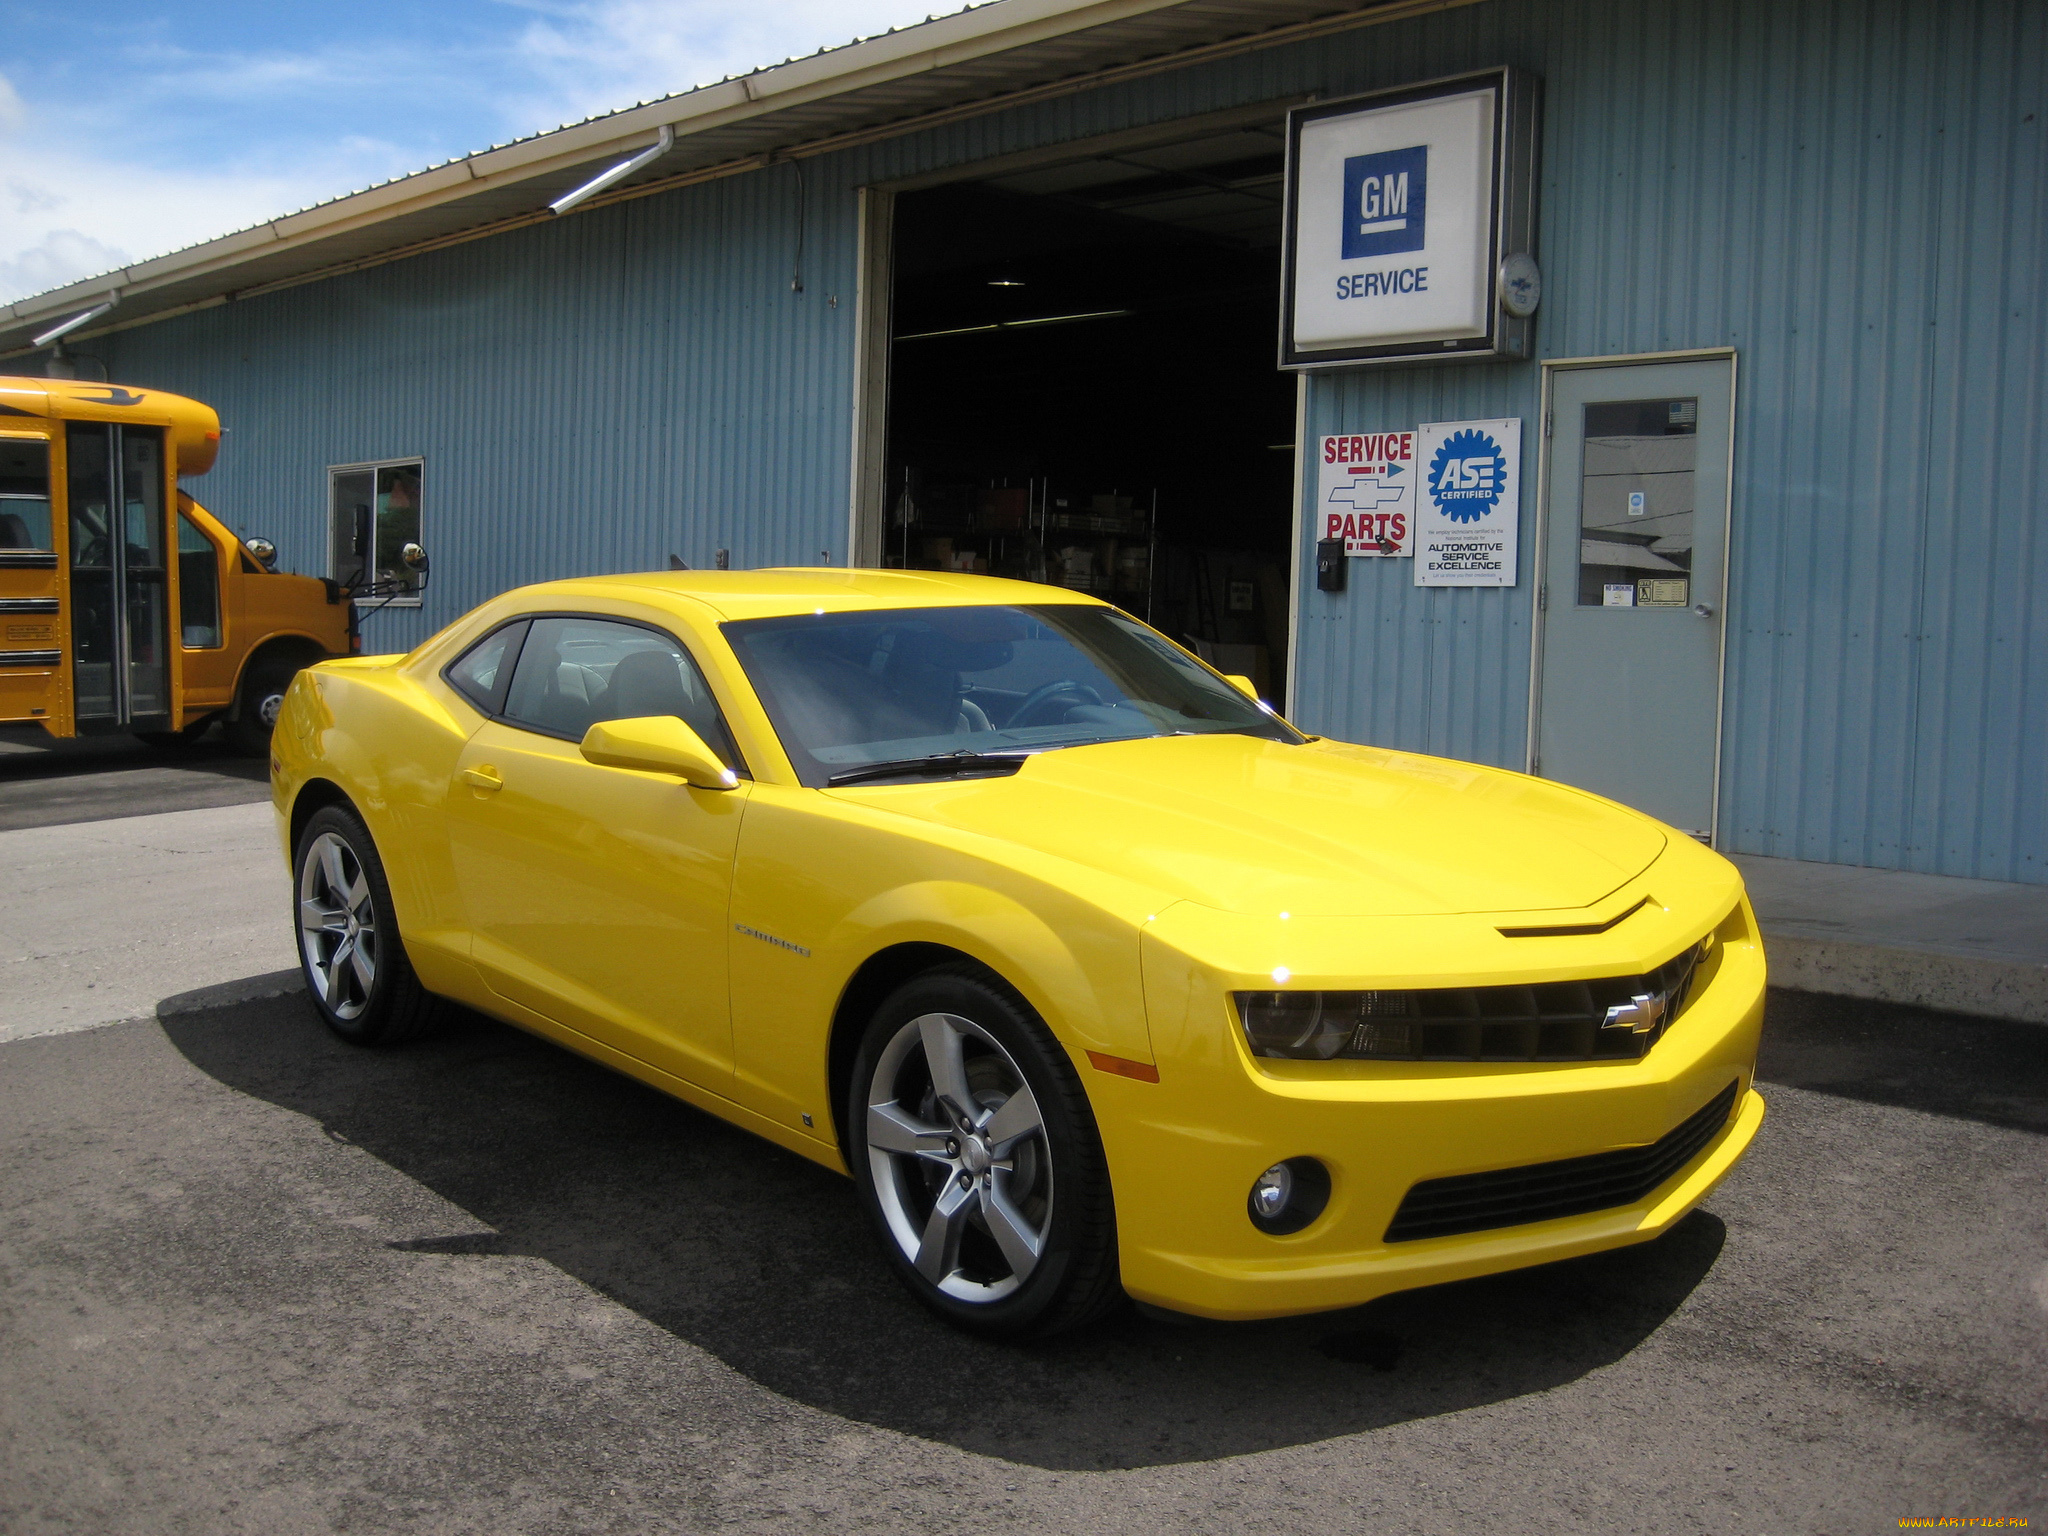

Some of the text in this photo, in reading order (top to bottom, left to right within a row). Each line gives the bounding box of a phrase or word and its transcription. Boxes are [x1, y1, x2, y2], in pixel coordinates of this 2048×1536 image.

[1361, 172, 1409, 220] GM
[1336, 267, 1429, 300] SERVICE
[1324, 433, 1412, 464] SERVICE
[1437, 456, 1495, 490] ASE
[1440, 489, 1492, 500] CERTIFIED
[1327, 513, 1406, 541] PARTS
[1428, 543, 1503, 552] AUTOMOTIVE
[1442, 553, 1489, 561] SERVICE
[1428, 562, 1502, 570] EXCELLENCE
